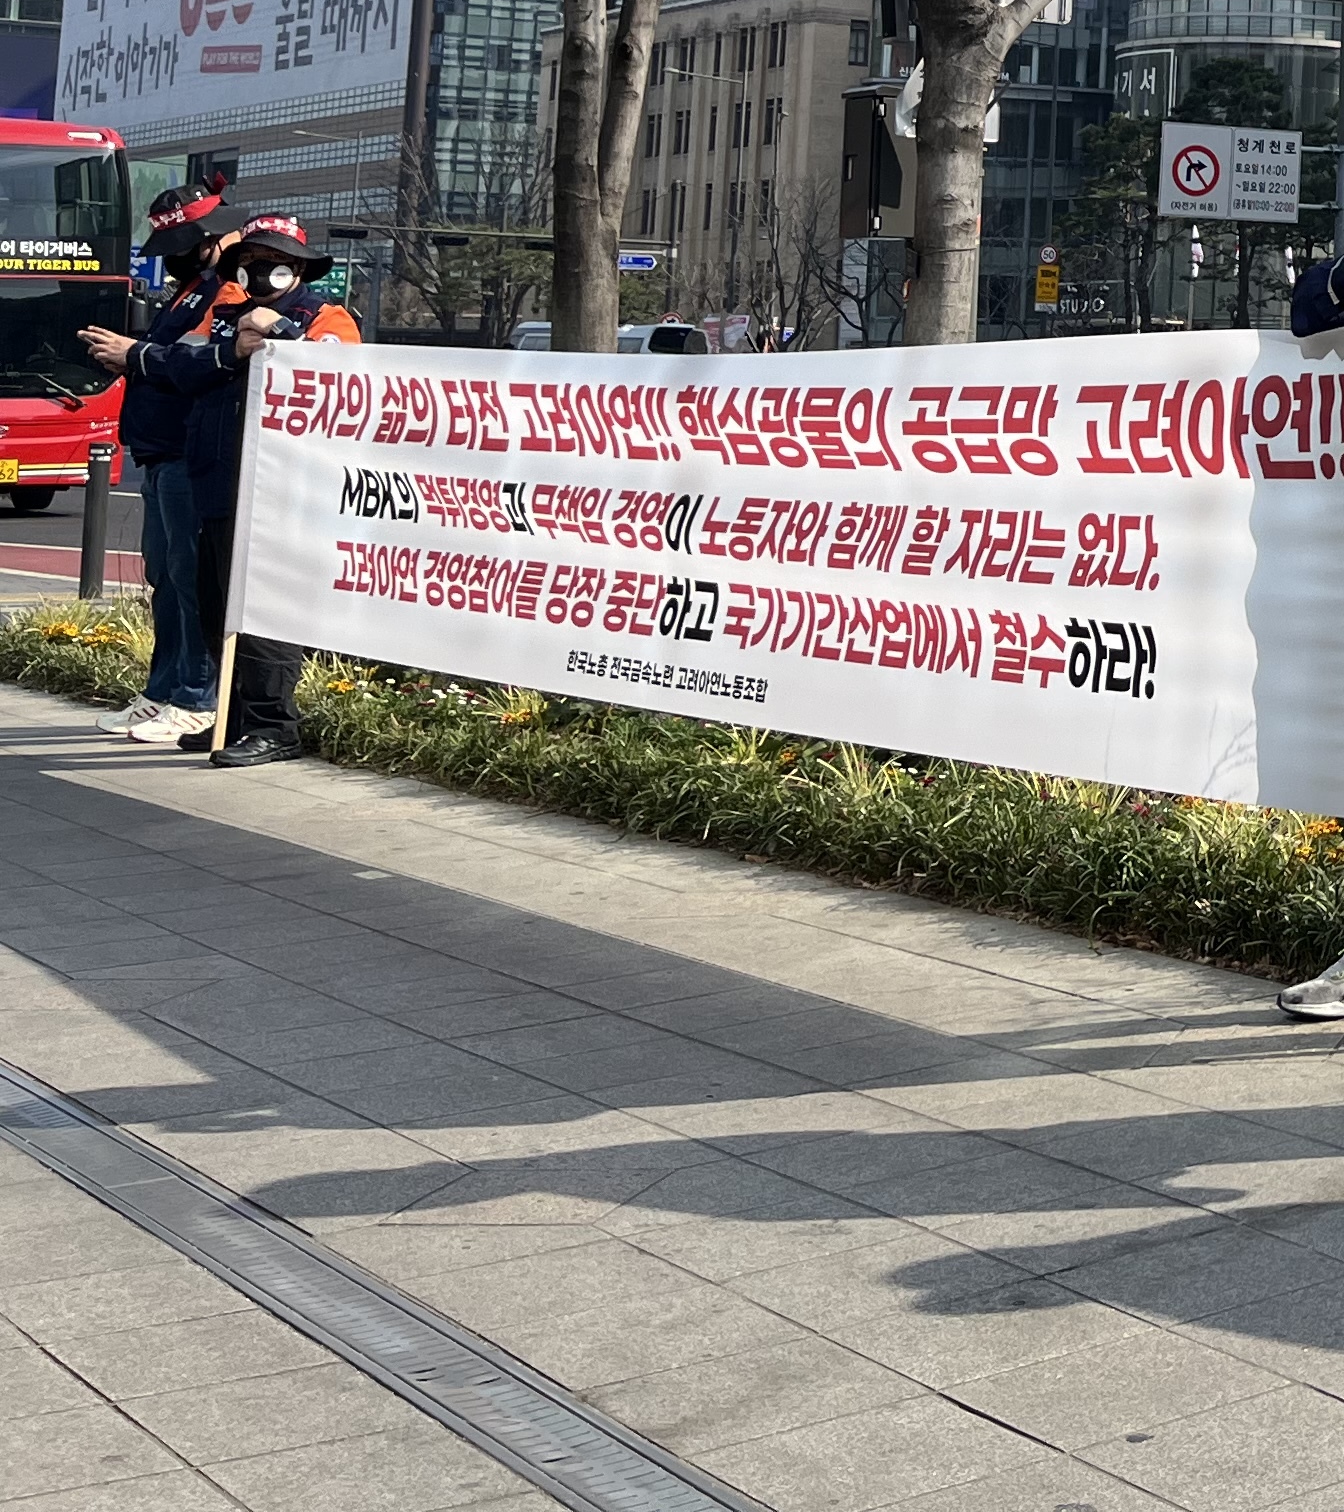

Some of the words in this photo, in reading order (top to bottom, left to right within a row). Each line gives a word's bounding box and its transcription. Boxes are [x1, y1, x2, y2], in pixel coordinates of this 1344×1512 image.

[1237, 138, 1297, 155] 청계천로
[1268, 182, 1296, 195] 22:00
[20, 240, 93, 257] 타이거버스
[1043, 250, 1054, 260] 50
[27, 259, 71, 271] TIGER
[74, 260, 100, 271] BUS
[261, 368, 371, 438] 노동자의
[373, 375, 440, 447] 삶의
[441, 380, 510, 452] 터전
[509, 383, 681, 461] 고려아연!!
[676, 385, 902, 471] 핵심광물의
[902, 384, 1058, 476] 공급망
[340, 466, 419, 524] MBK의
[416, 474, 535, 535] 먹튀경영과
[531, 483, 611, 545] 무책임
[612, 488, 704, 555] 경영이
[699, 496, 833, 567] 노동자와
[827, 501, 908, 573] 함께
[901, 505, 951, 576] 할
[943, 508, 1066, 585] 자리는
[1068, 513, 1160, 591] 없다.
[333, 541, 422, 604] 고려아연
[423, 550, 548, 621] 경영참여를
[545, 563, 606, 628] 당장
[602, 570, 720, 642] 중단하고
[723, 583, 982, 678] 국가기간산업에서
[991, 609, 1157, 700] 철수하라!
[567, 649, 609, 678] 한국노총
[609, 656, 675, 689] 전국금속노련
[676, 666, 769, 704] 고려아연노동조합
